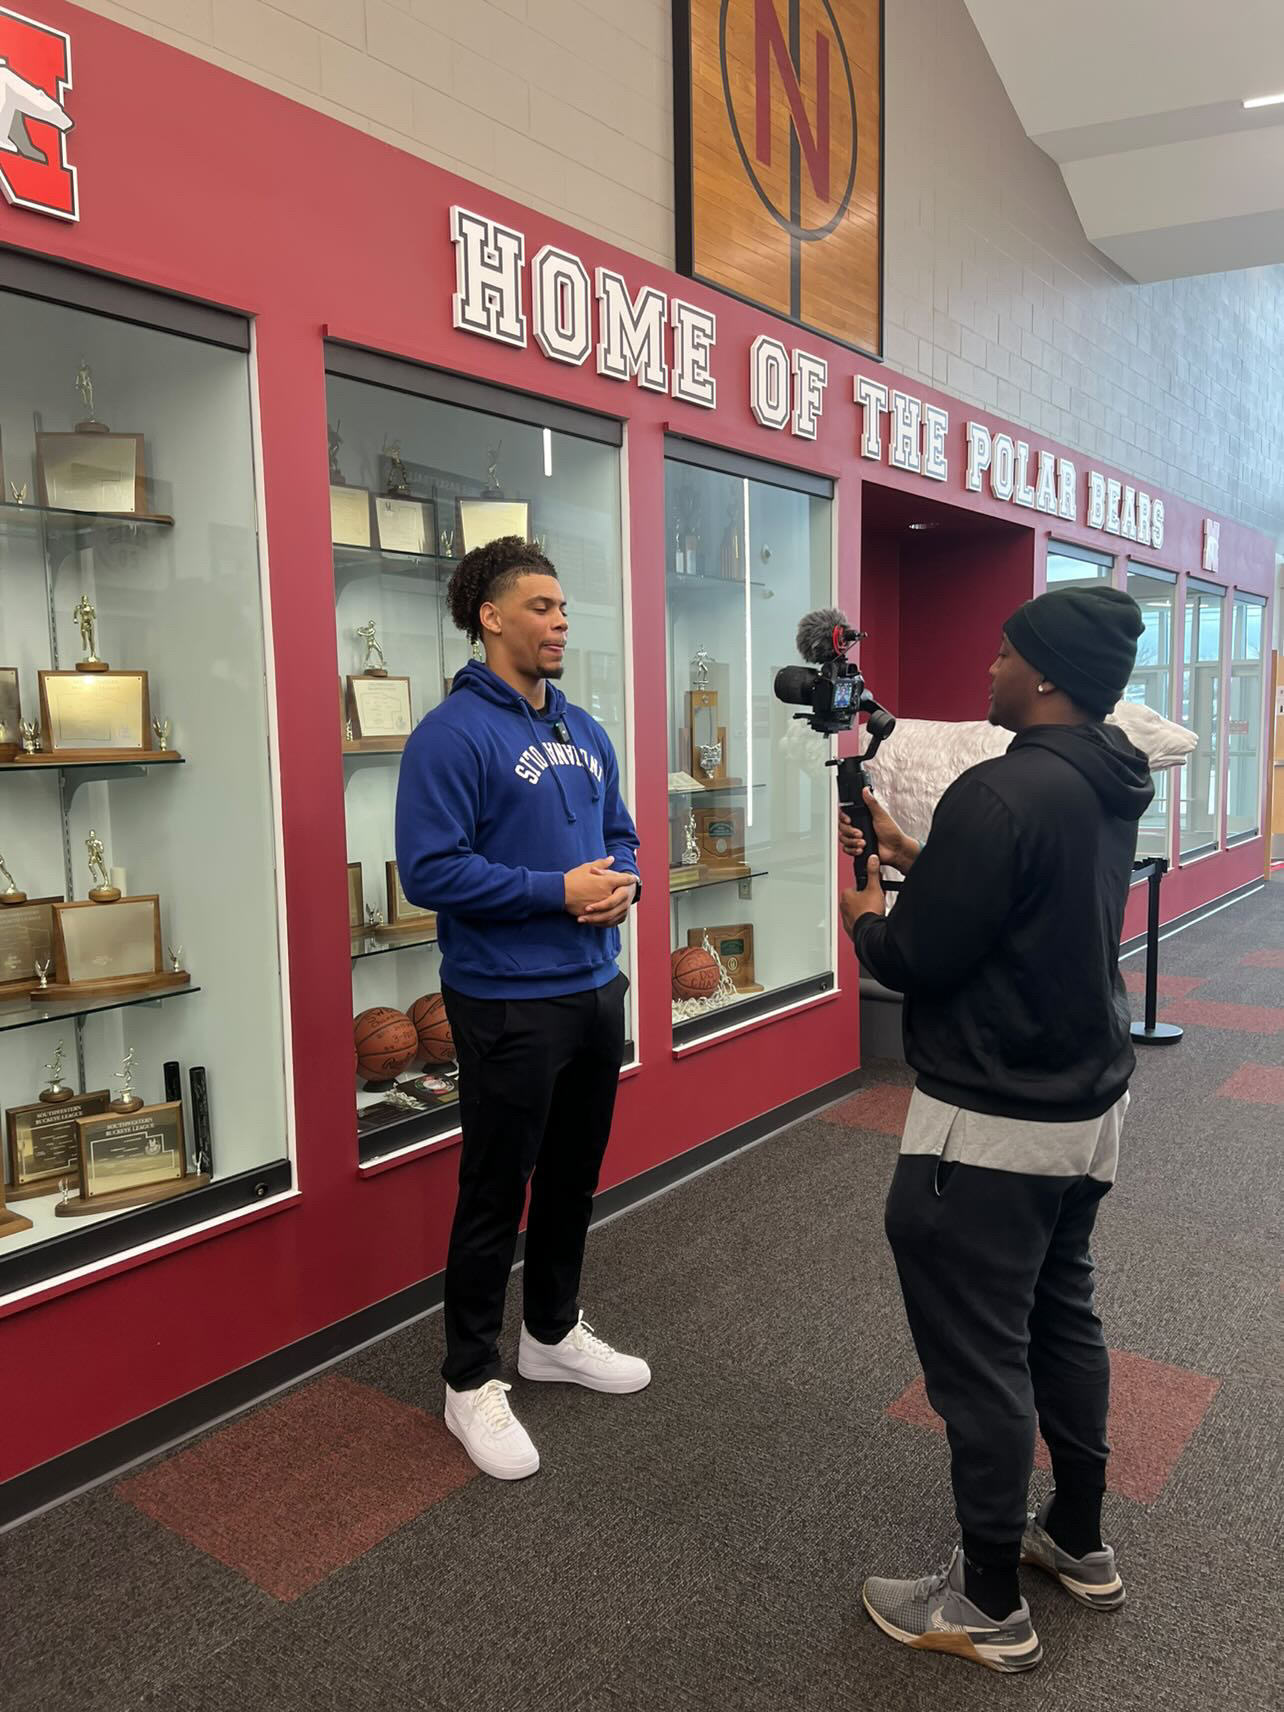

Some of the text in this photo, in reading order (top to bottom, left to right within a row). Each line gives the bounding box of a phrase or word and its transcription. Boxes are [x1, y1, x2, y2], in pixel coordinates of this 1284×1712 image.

[755, 0, 830, 204] N
[450, 205, 1165, 549] HOME OF THE POLAR BEARS
